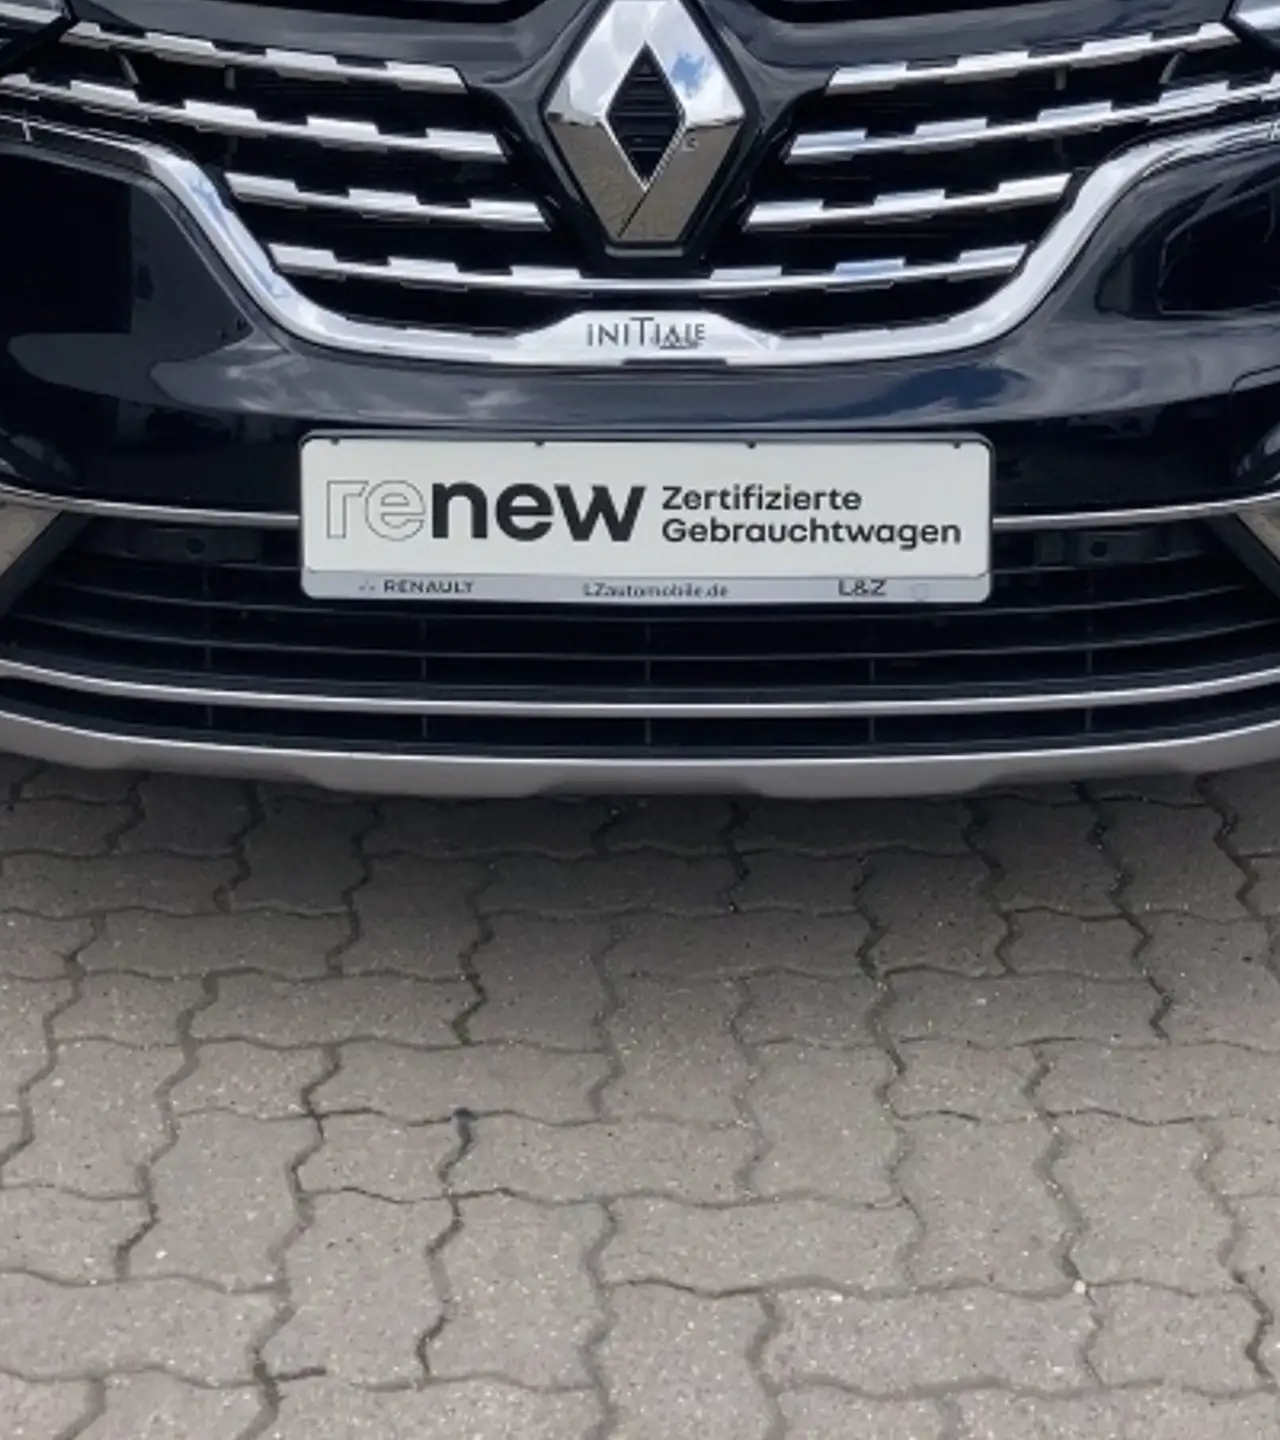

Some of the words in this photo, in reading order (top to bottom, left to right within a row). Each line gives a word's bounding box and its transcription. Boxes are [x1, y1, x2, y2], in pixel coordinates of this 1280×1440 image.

[587, 316, 705, 348] INITIALE
[326, 479, 647, 542] renew
[661, 484, 862, 511] Zertifizierte
[661, 516, 962, 551] Gebrauchtwagen
[383, 579, 474, 594] RENAULT
[838, 578, 887, 597] L&Z
